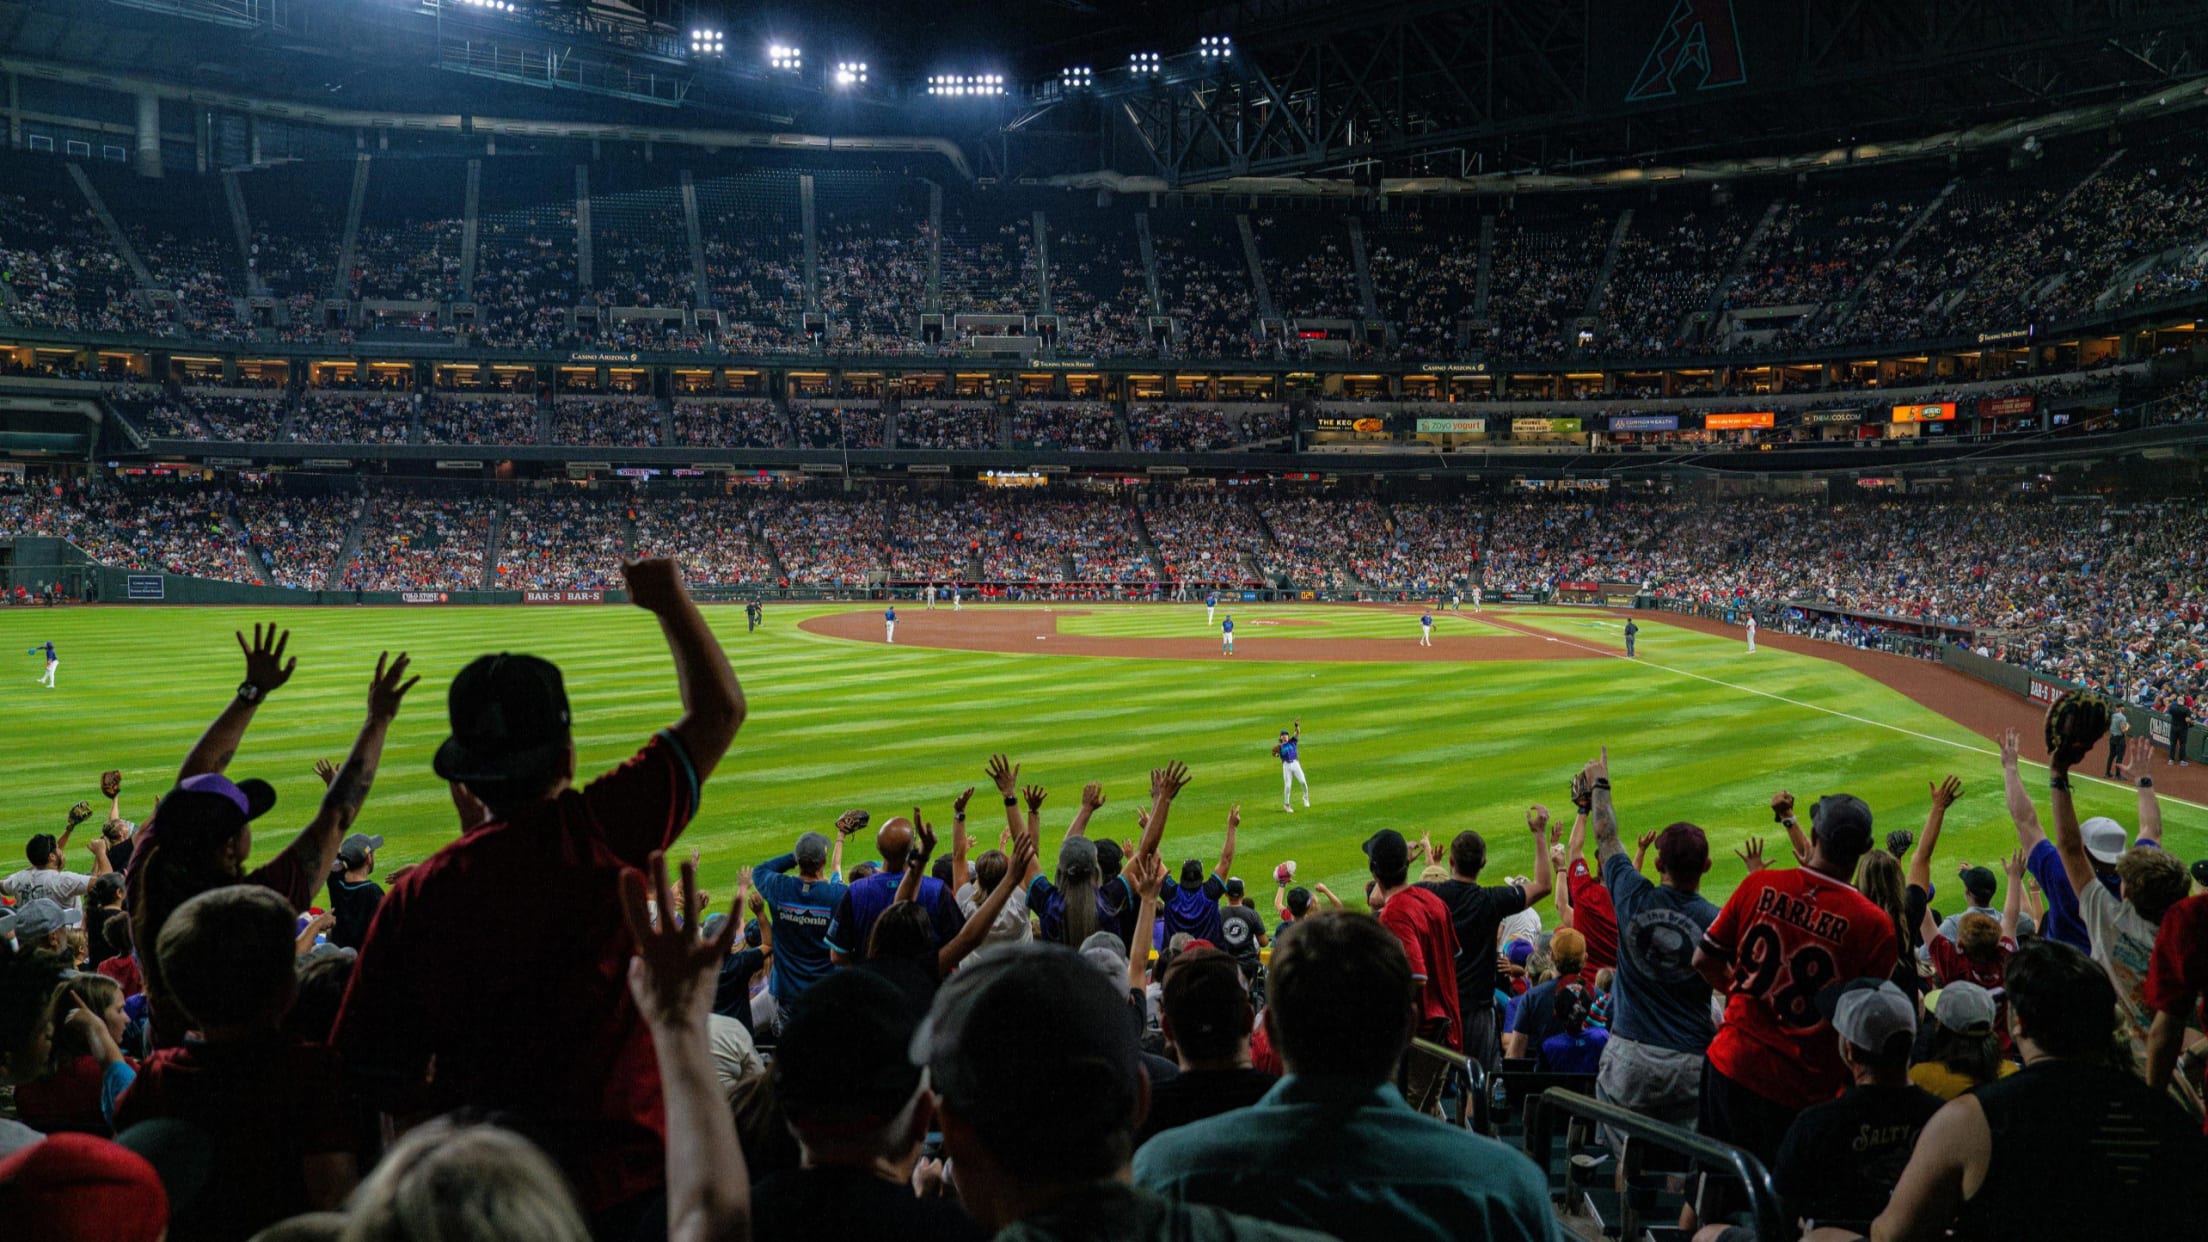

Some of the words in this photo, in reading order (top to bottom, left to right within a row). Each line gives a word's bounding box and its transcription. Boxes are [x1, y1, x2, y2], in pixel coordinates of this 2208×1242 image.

[572, 353, 597, 361] CASINO
[598, 353, 628, 361] ARIZONA
[1432, 421, 1451, 430] zoyo
[1453, 421, 1480, 431] yogurt
[528, 592, 560, 601] BAR-S
[567, 592, 600, 601] BAR-S
[2031, 681, 2049, 700] BAR-S
[780, 911, 827, 926] patagonia
[1757, 887, 1849, 944] BARLER
[1729, 920, 1839, 1034] 98
